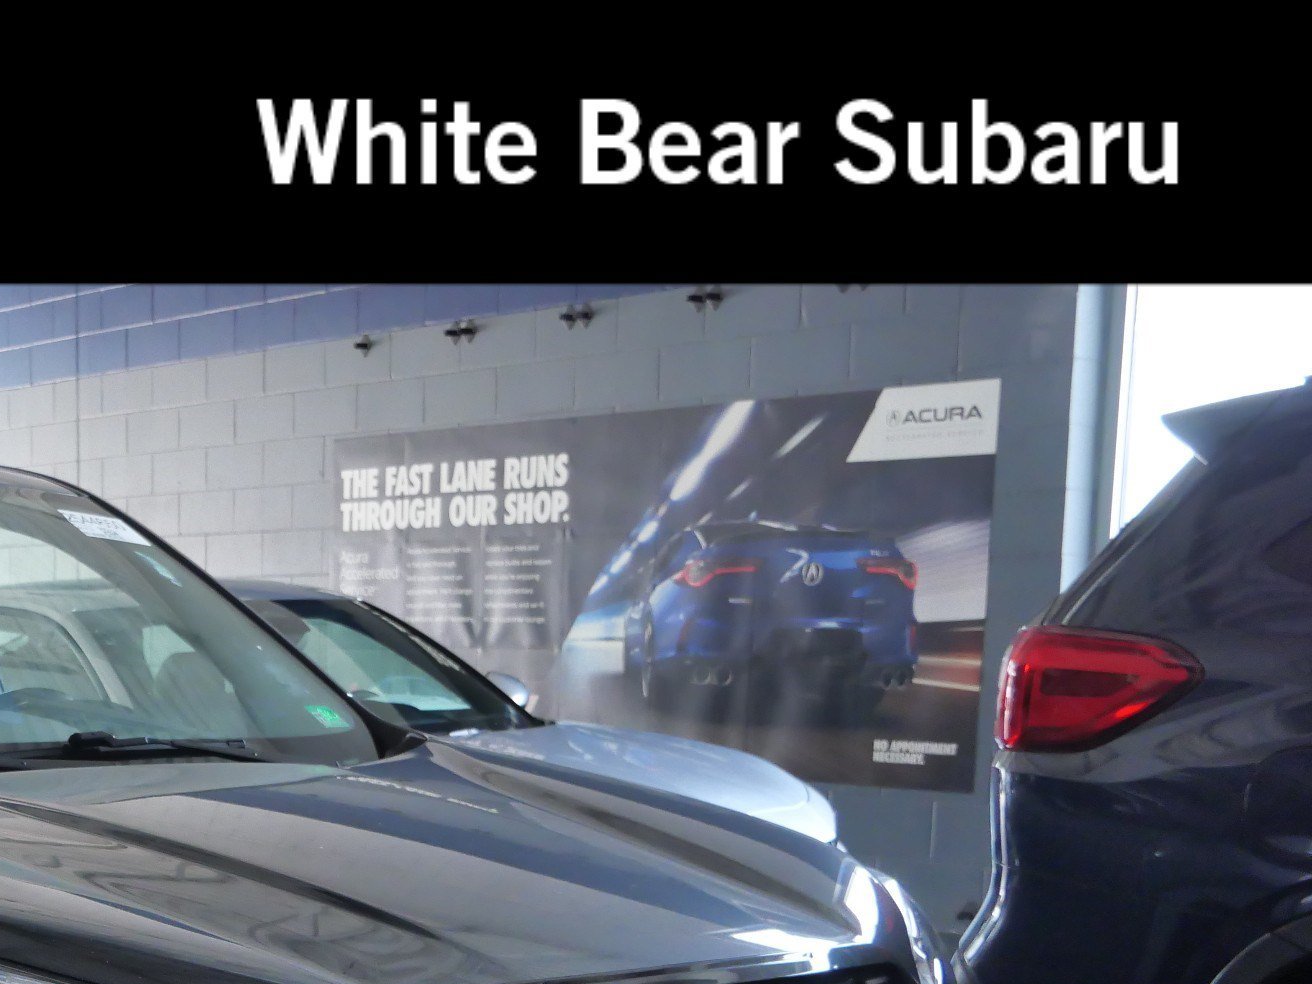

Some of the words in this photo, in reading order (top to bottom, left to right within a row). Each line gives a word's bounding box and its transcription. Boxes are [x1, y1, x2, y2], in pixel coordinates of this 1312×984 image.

[903, 405, 983, 424] ACURA
[341, 468, 378, 499] THE
[385, 463, 434, 497] FAST
[440, 459, 497, 493] LANE
[504, 453, 569, 490] RUNS
[340, 497, 441, 532] THROUGH
[449, 494, 498, 528] OUR
[504, 490, 570, 525] SHOP.
